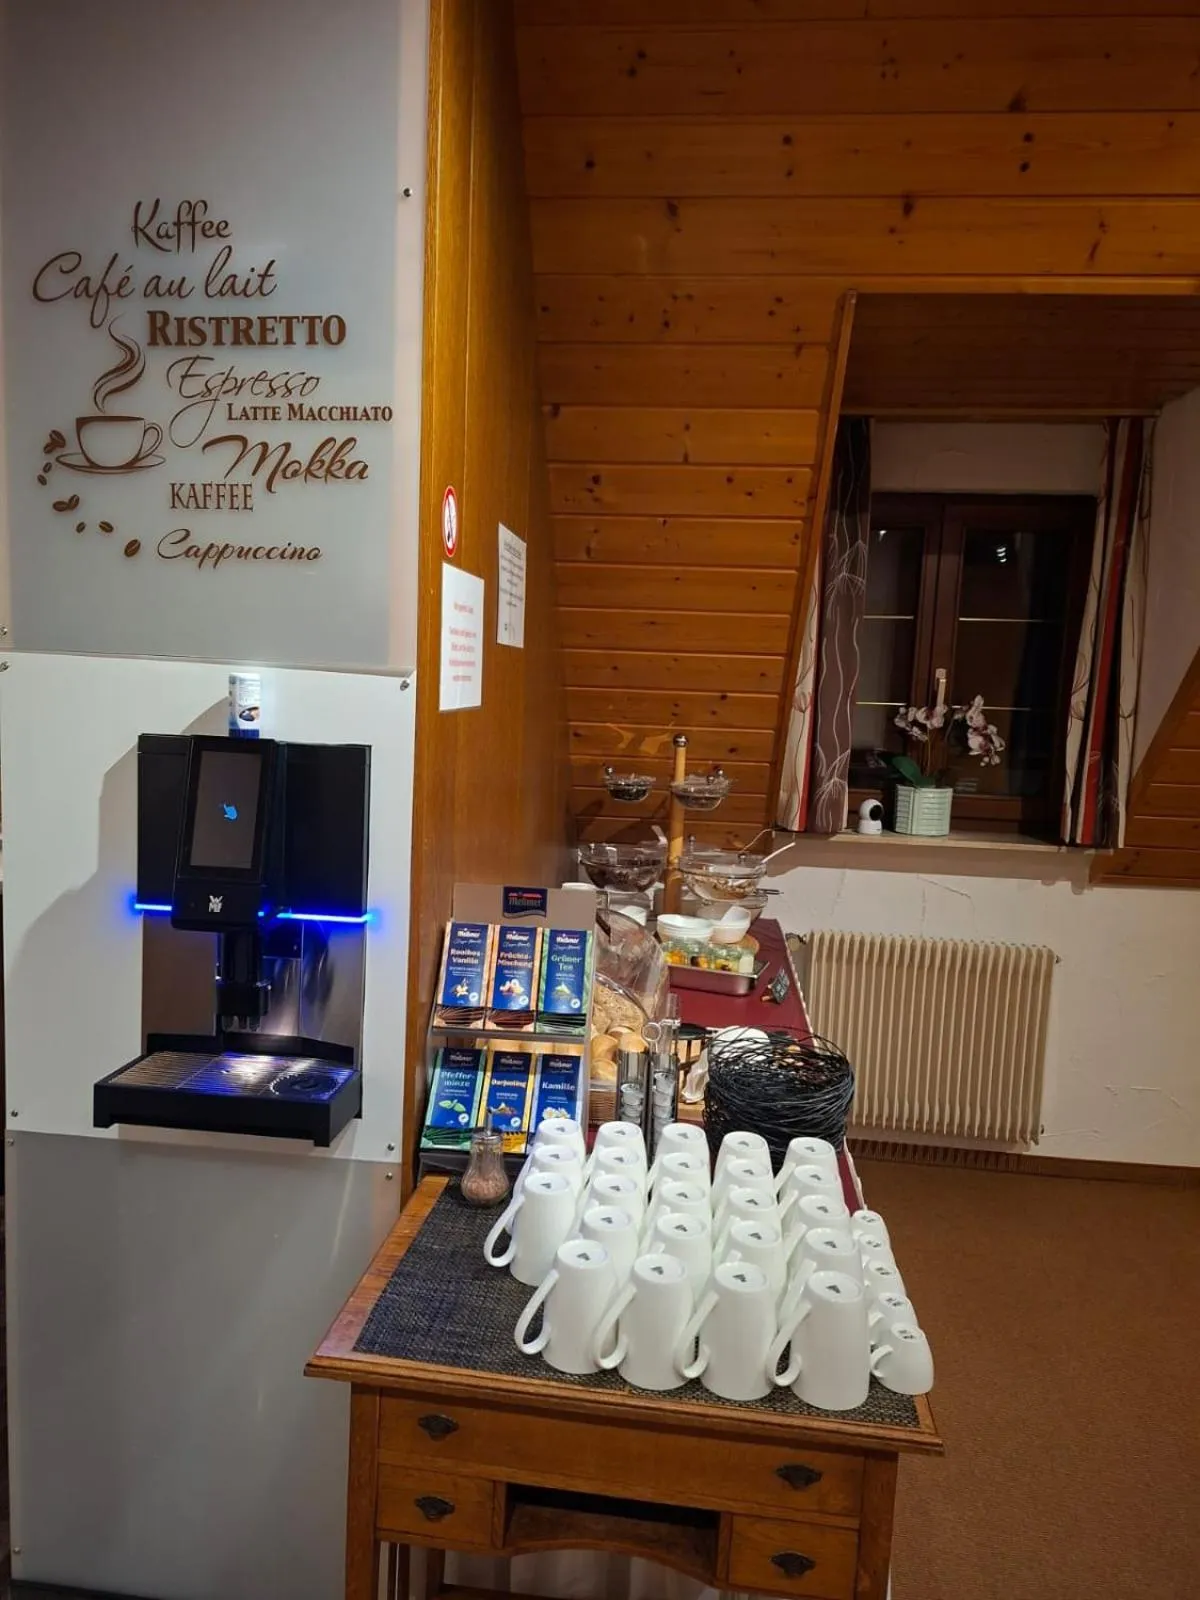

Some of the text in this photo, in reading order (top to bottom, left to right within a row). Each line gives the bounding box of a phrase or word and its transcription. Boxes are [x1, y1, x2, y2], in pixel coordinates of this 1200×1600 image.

[131, 198, 232, 253] Kaffee
[32, 245, 277, 329] Café au lait
[147, 310, 347, 346] RISTRETTO
[166, 354, 320, 449] Espresso
[227, 403, 393, 423] LATTE MACCHIATO
[202, 434, 370, 494] Mokka
[169, 482, 254, 511] KAFFEE
[157, 528, 321, 569] Cappuccino
[542, 1081, 576, 1091] Kamille
